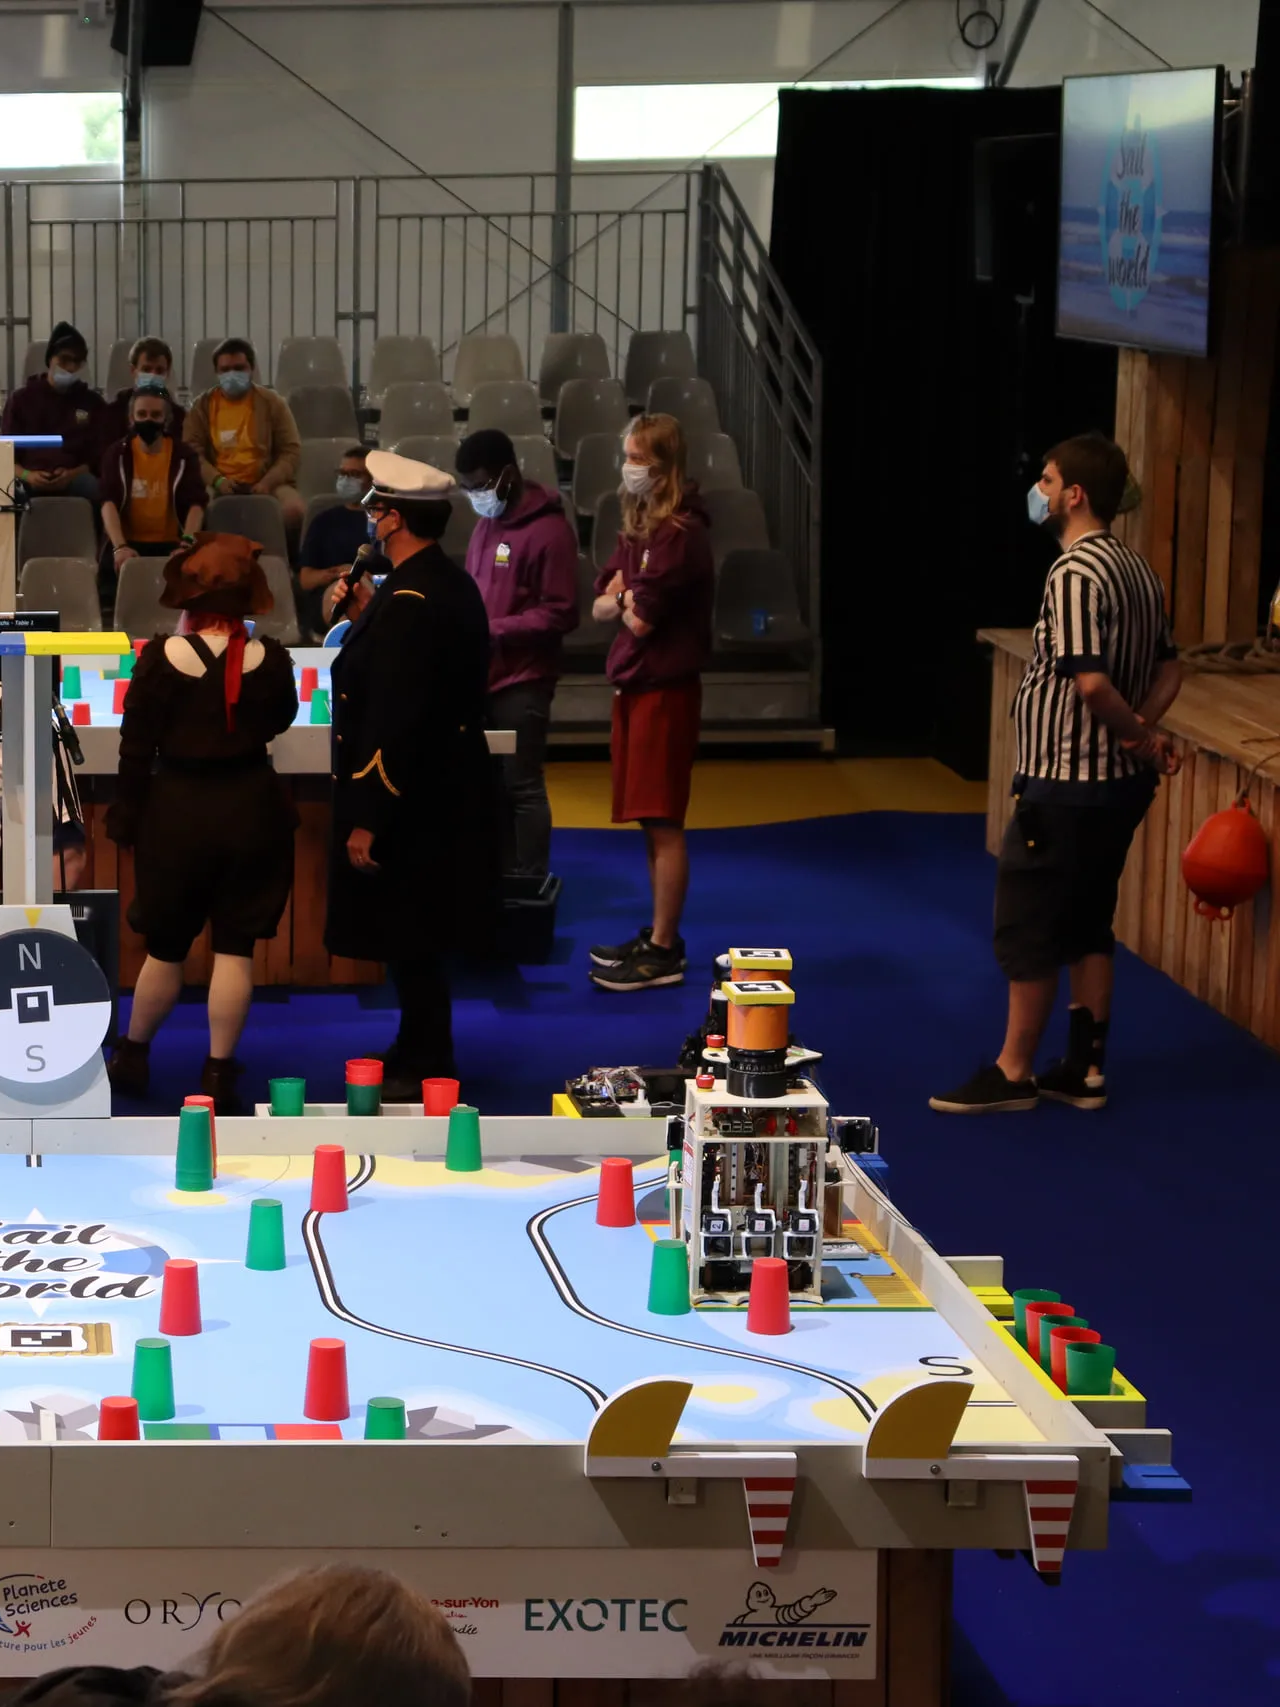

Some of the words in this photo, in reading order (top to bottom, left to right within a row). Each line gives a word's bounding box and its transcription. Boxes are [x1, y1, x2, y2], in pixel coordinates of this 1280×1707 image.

[1117, 132, 1148, 179] Sail
[1119, 189, 1140, 236] the
[1107, 244, 1151, 289] world
[19, 942, 42, 971] N
[25, 1044, 46, 1072] S
[918, 1356, 974, 1376] S
[4, 1592, 79, 1618] Sciences
[524, 1598, 689, 1632] EXOTEC
[23, 1642, 48, 1653] pour
[50, 1638, 67, 1649] les
[67, 1615, 98, 1645] jeunes
[718, 1631, 869, 1647] MICHELIN
